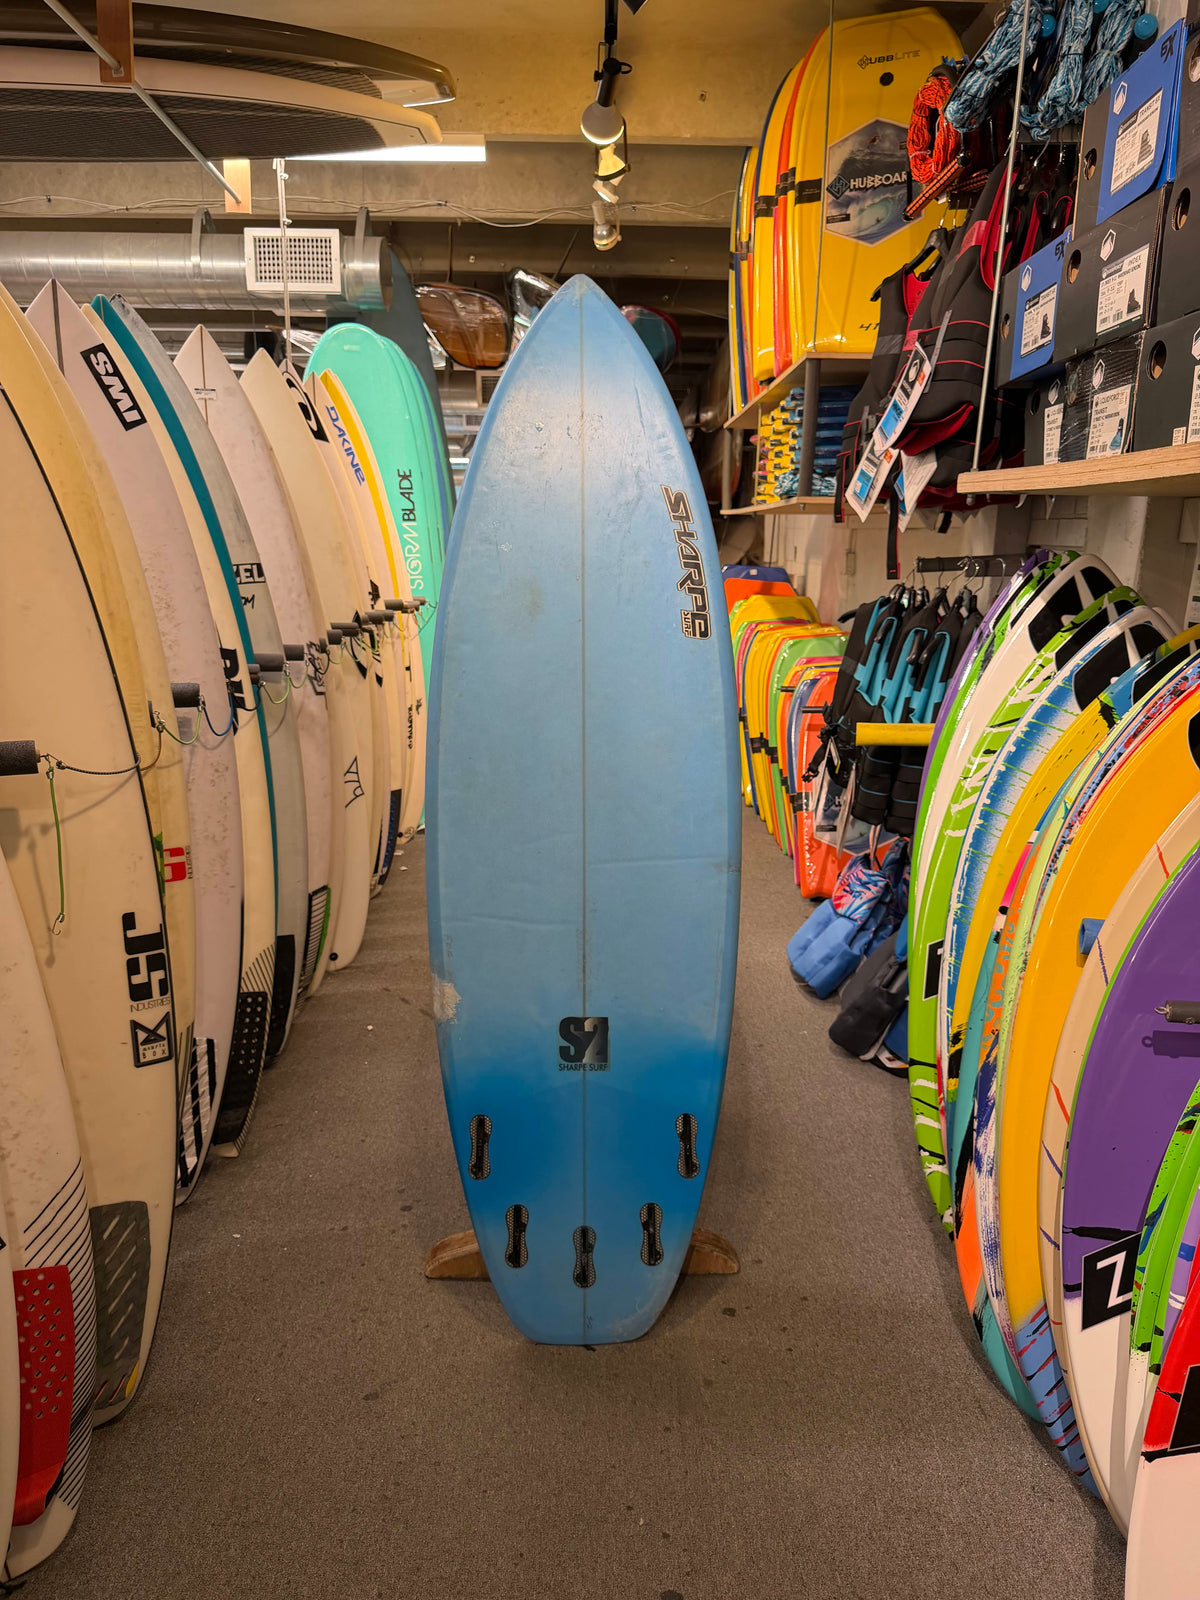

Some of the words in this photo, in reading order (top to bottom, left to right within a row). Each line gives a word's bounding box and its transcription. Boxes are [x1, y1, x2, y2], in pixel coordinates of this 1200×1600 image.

[325, 405, 366, 486] DAKINE
[661, 484, 711, 640] SHARPE
[682, 611, 692, 637] SURF
[130, 997, 171, 1012] INDUSTRIES
[142, 1048, 167, 1059] BOX
[558, 1063, 587, 1072] SHARPE
[588, 1063, 609, 1072] SURF
